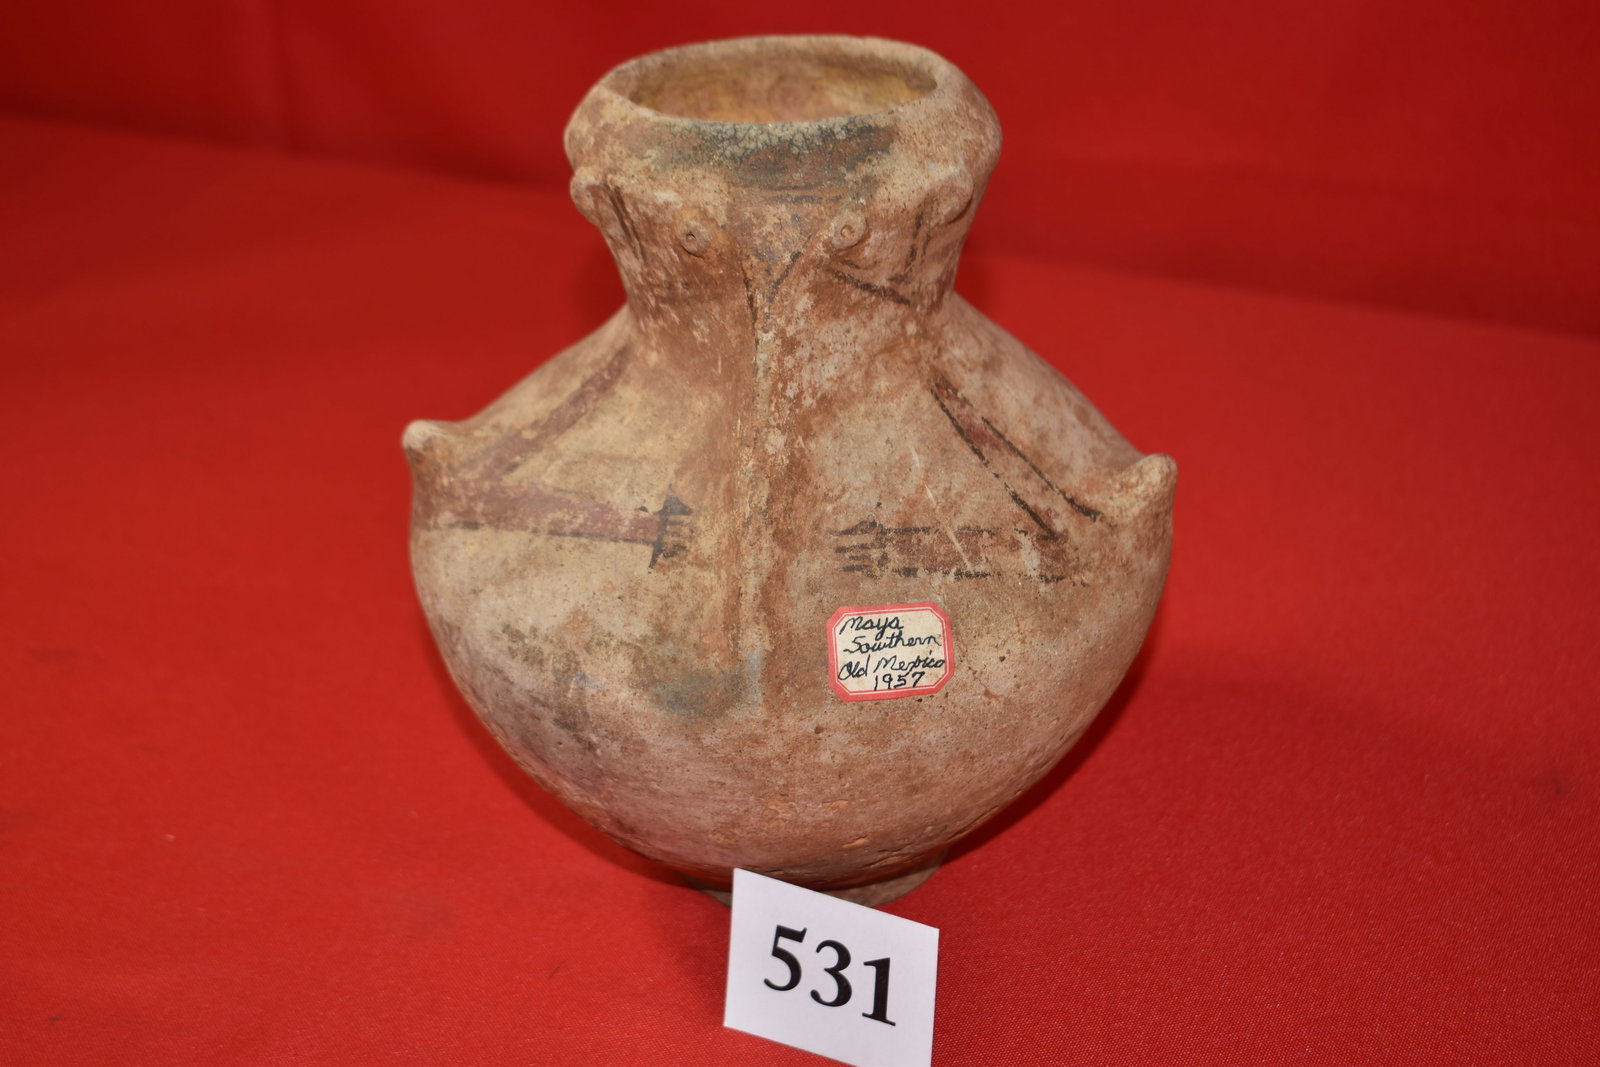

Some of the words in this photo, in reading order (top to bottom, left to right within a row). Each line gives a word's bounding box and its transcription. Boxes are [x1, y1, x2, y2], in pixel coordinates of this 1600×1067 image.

[839, 616, 904, 641] Maya
[843, 630, 942, 653] Southern
[838, 654, 870, 680] Old
[873, 650, 945, 675] Mexico
[874, 671, 925, 691] 1957
[764, 924, 896, 1026] 531
